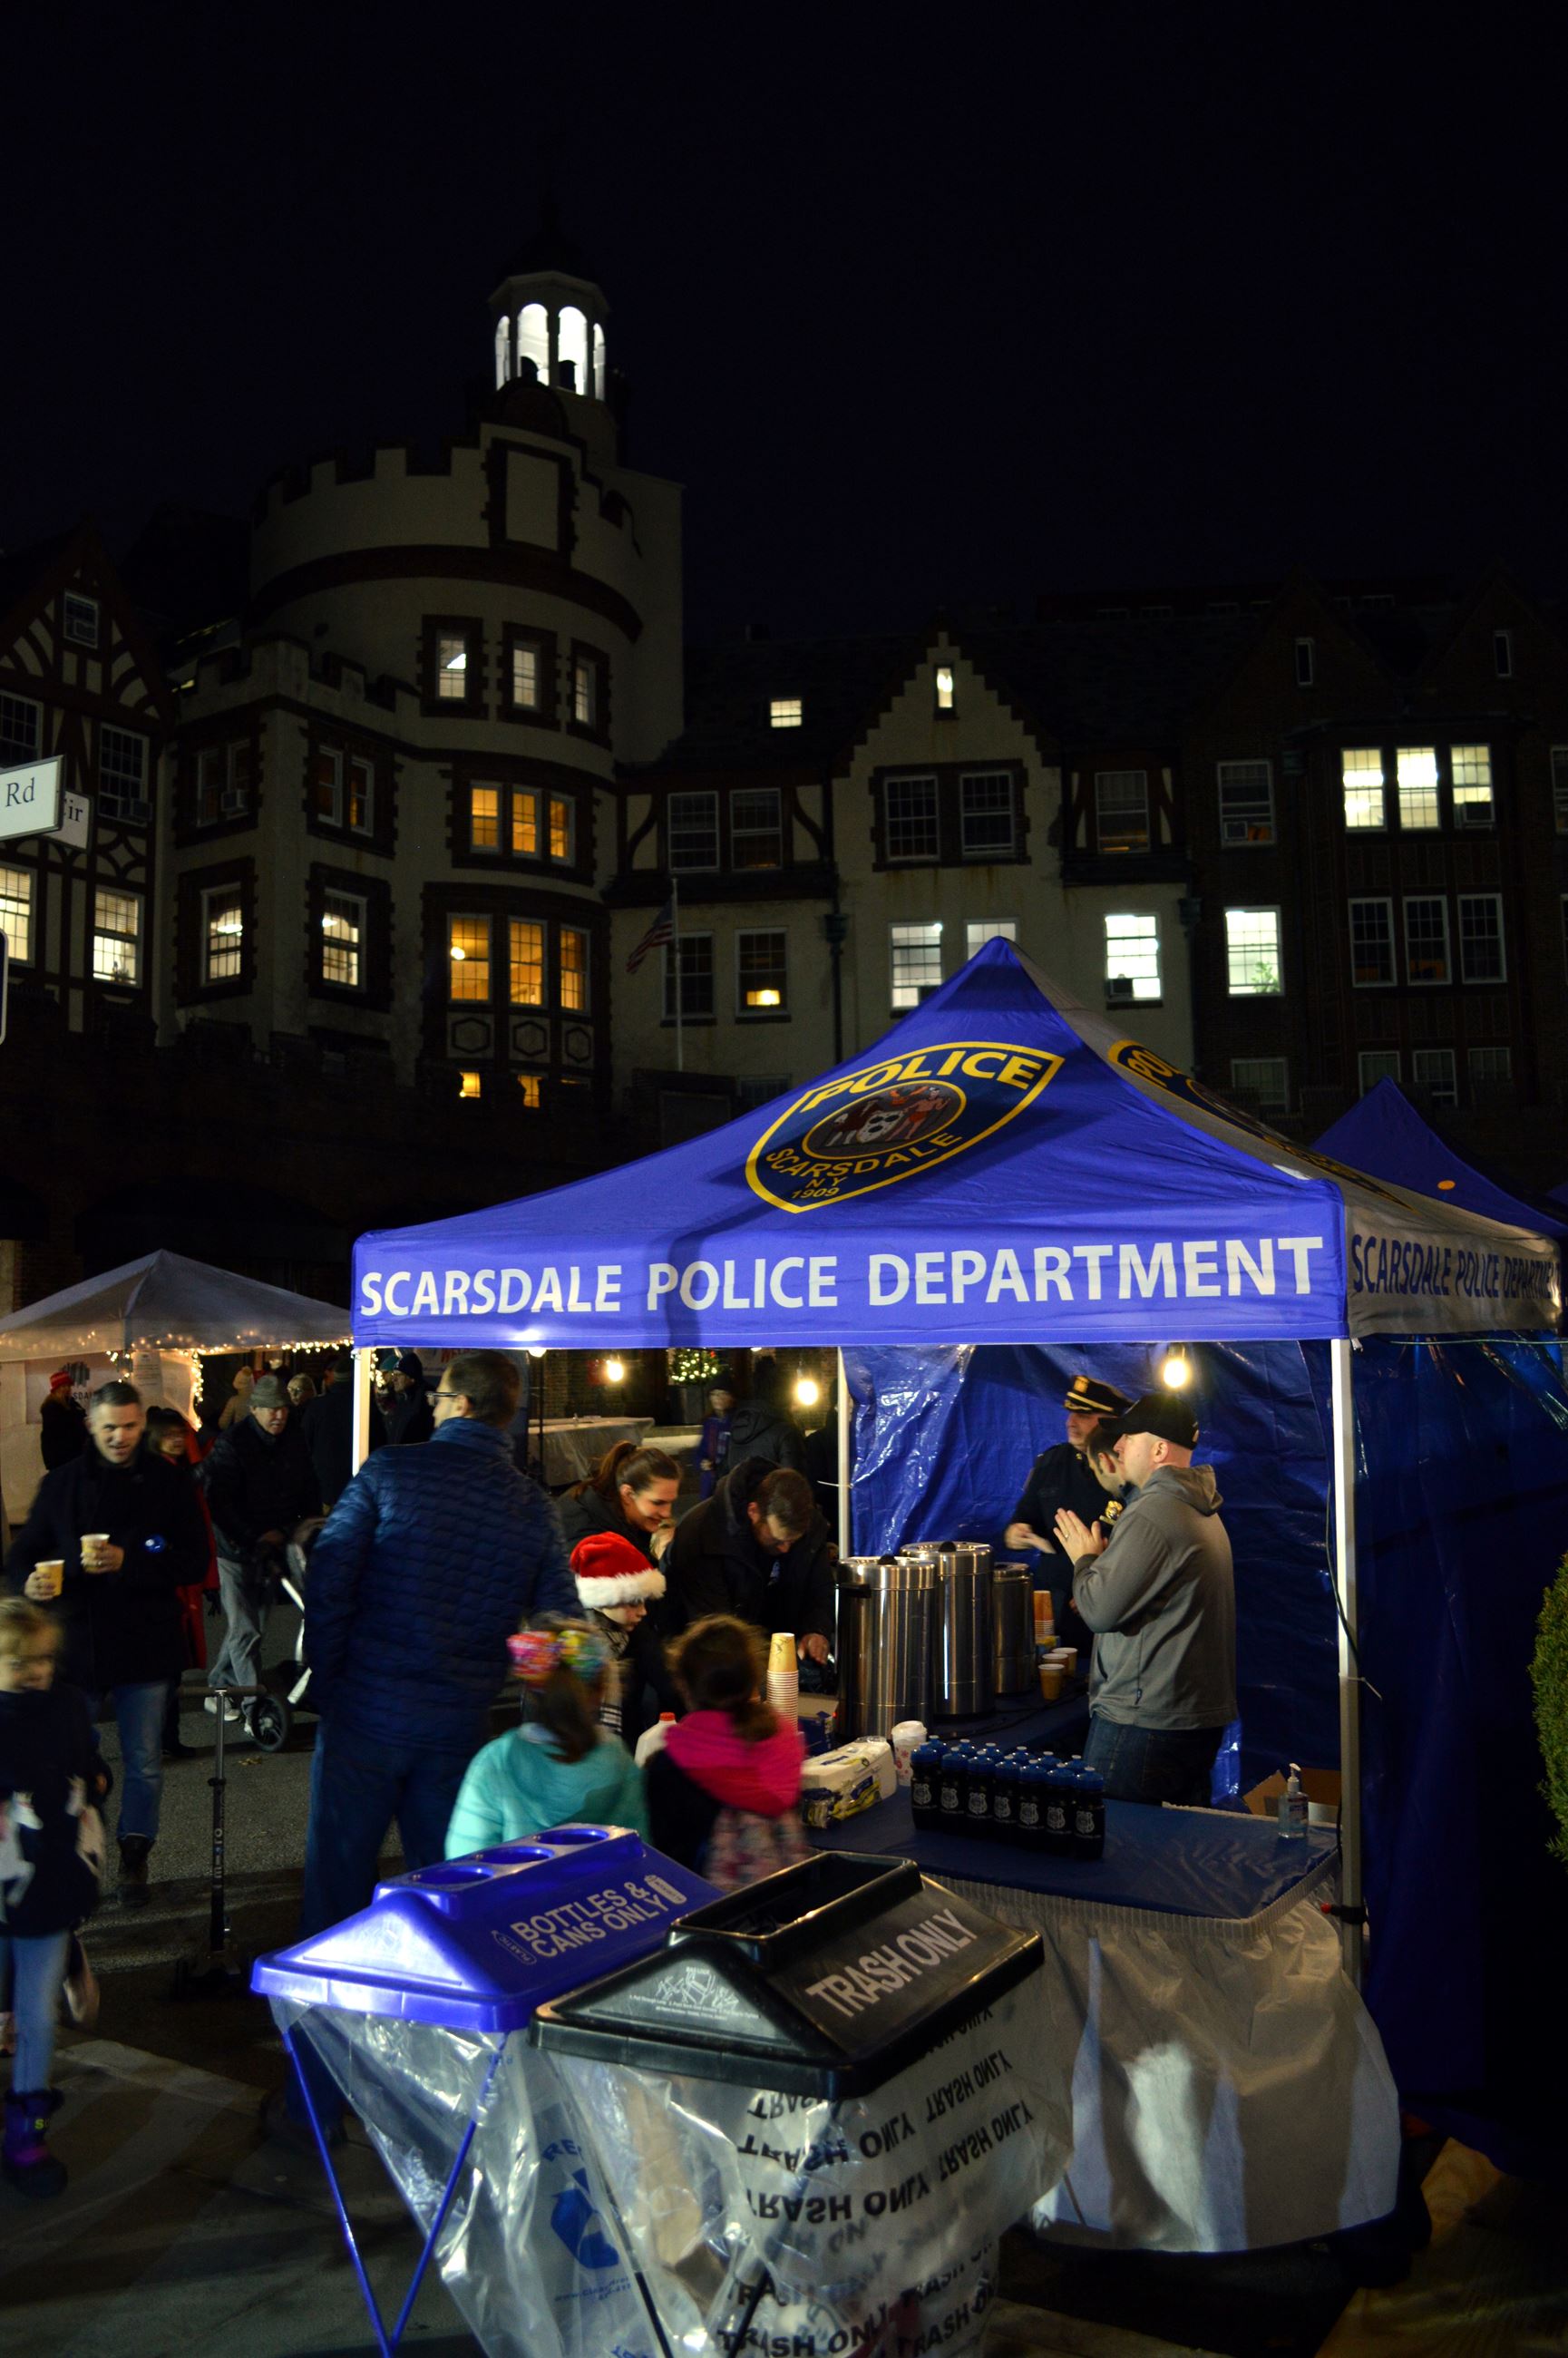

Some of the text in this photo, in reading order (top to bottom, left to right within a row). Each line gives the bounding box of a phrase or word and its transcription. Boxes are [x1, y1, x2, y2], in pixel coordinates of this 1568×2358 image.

[6, 777, 35, 807] Rd
[63, 798, 83, 823] ir
[799, 1049, 1043, 1114] POLICE
[765, 1131, 963, 1179] SCARSDALE
[790, 1186, 842, 1199] 1909
[360, 1236, 1323, 1317] SCARSDALE POLICE DEPARTMENT
[1351, 1233, 1451, 1296] SCARSDALE
[1456, 1250, 1499, 1298] POLICE
[510, 1888, 628, 1943] BOTTLES
[623, 1881, 651, 1900] &
[530, 1893, 669, 1959] CANS ONLY
[804, 1907, 979, 2018] TRASH ONLY
